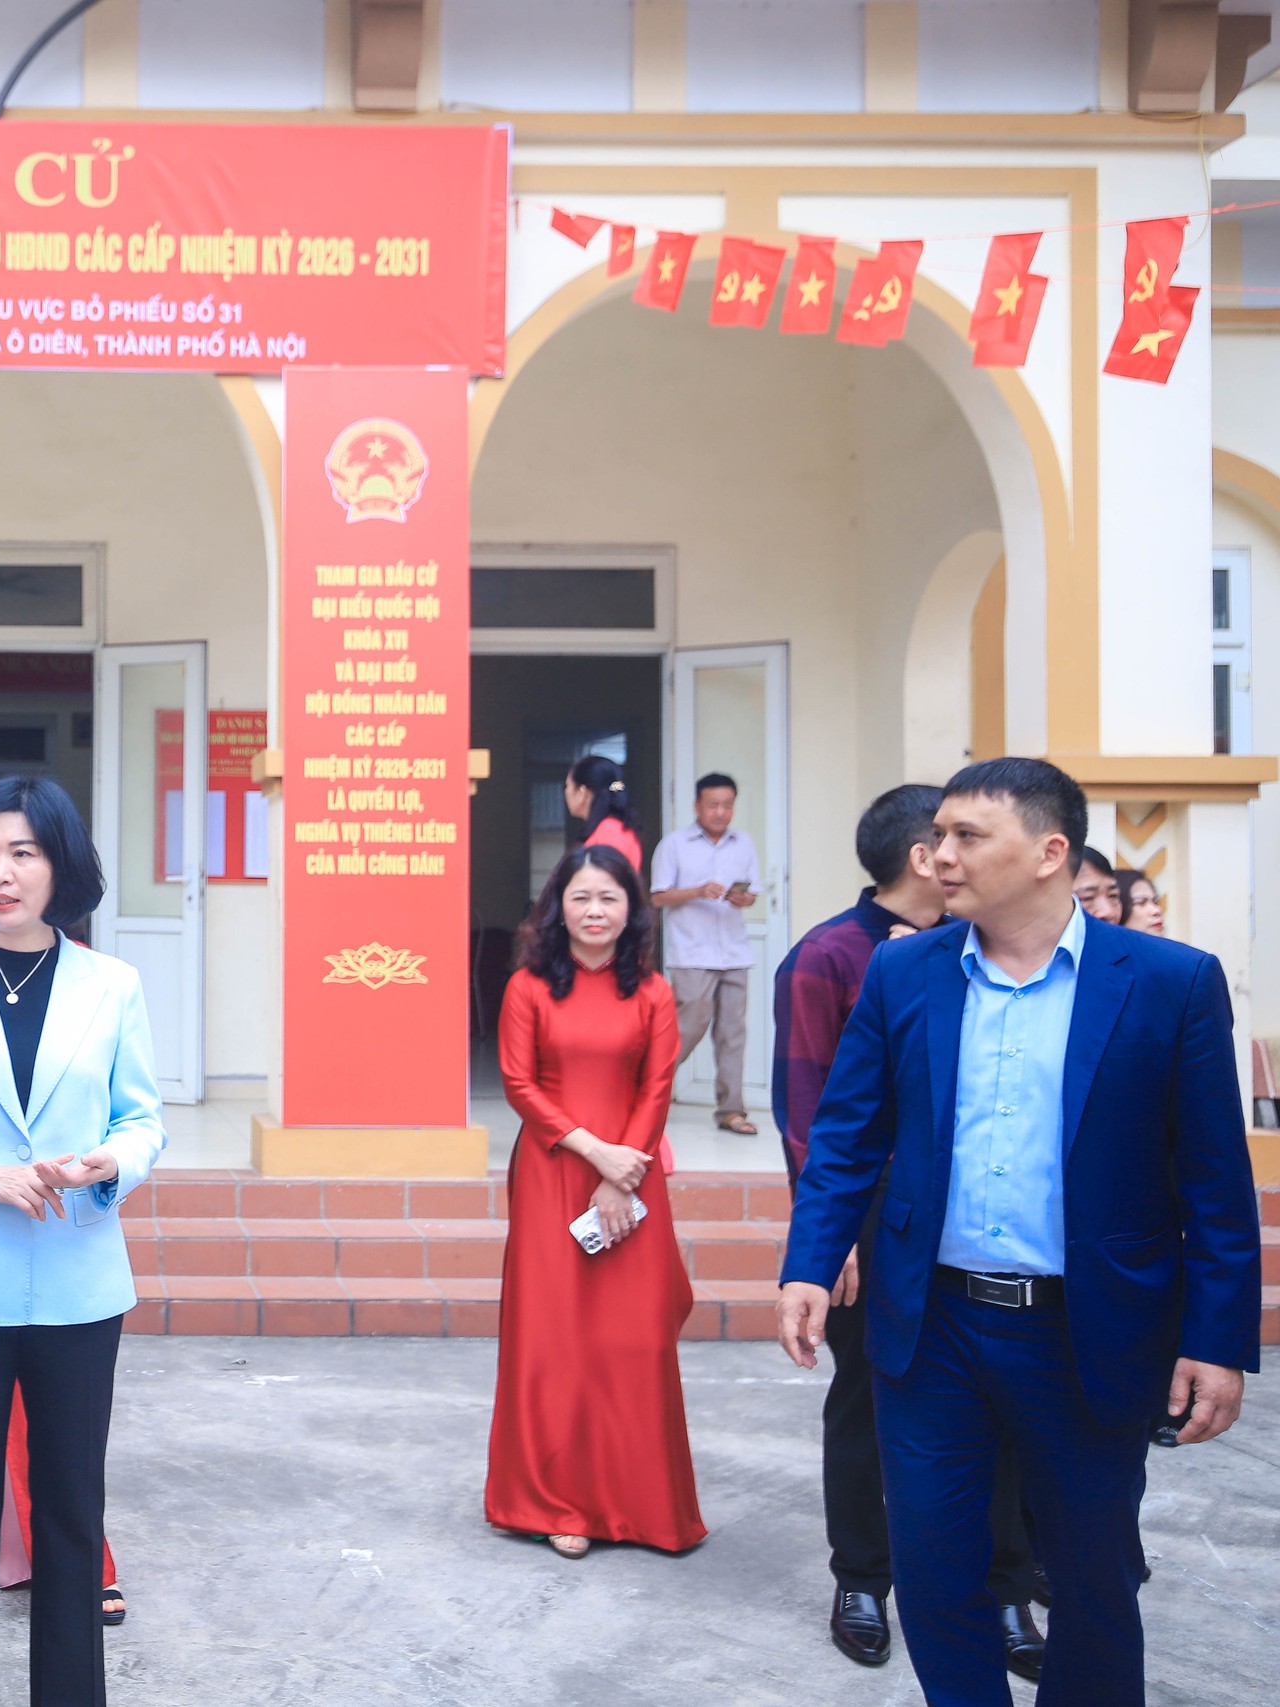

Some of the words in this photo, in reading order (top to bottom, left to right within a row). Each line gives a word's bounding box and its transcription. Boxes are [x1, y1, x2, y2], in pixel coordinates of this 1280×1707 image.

[14, 136, 136, 208] CỬ
[75, 225, 123, 273] CÁC
[127, 220, 175, 273] CẤP
[180, 227, 257, 282] NHIỆM
[261, 228, 293, 275] KỲ
[297, 236, 355, 276] 2026
[374, 236, 430, 276] 2031
[18, 297, 66, 324] VỰC
[71, 292, 105, 322] BỎ
[109, 293, 177, 323] PHIẾU
[182, 293, 215, 323] SỐ
[218, 303, 242, 324] 31
[5, 327, 25, 353] Ô
[29, 328, 88, 358] DIÊN,
[93, 329, 171, 356] THÀNH
[177, 328, 225, 357] PHỐ
[230, 331, 262, 358] HÀ
[266, 331, 306, 362] NỘI
